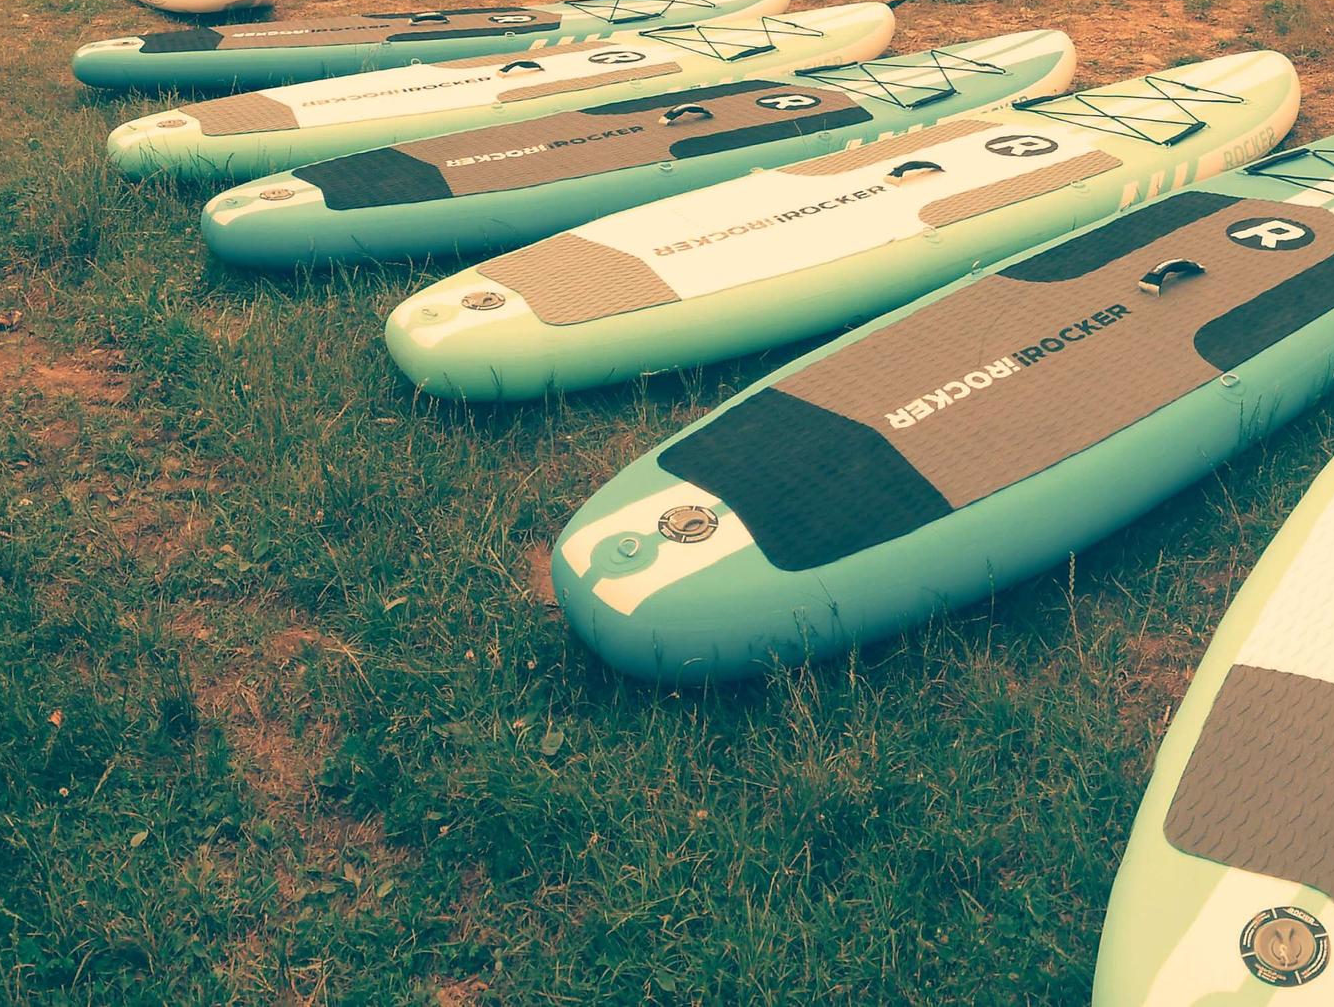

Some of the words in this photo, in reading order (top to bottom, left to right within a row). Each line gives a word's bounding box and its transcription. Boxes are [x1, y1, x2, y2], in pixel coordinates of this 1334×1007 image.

[548, 126, 645, 150] iROCKER
[773, 184, 887, 223] iROCKER
[653, 217, 774, 257] iROCKER
[1012, 303, 1132, 367] iROCKER
[884, 356, 1021, 429] iROCKER
